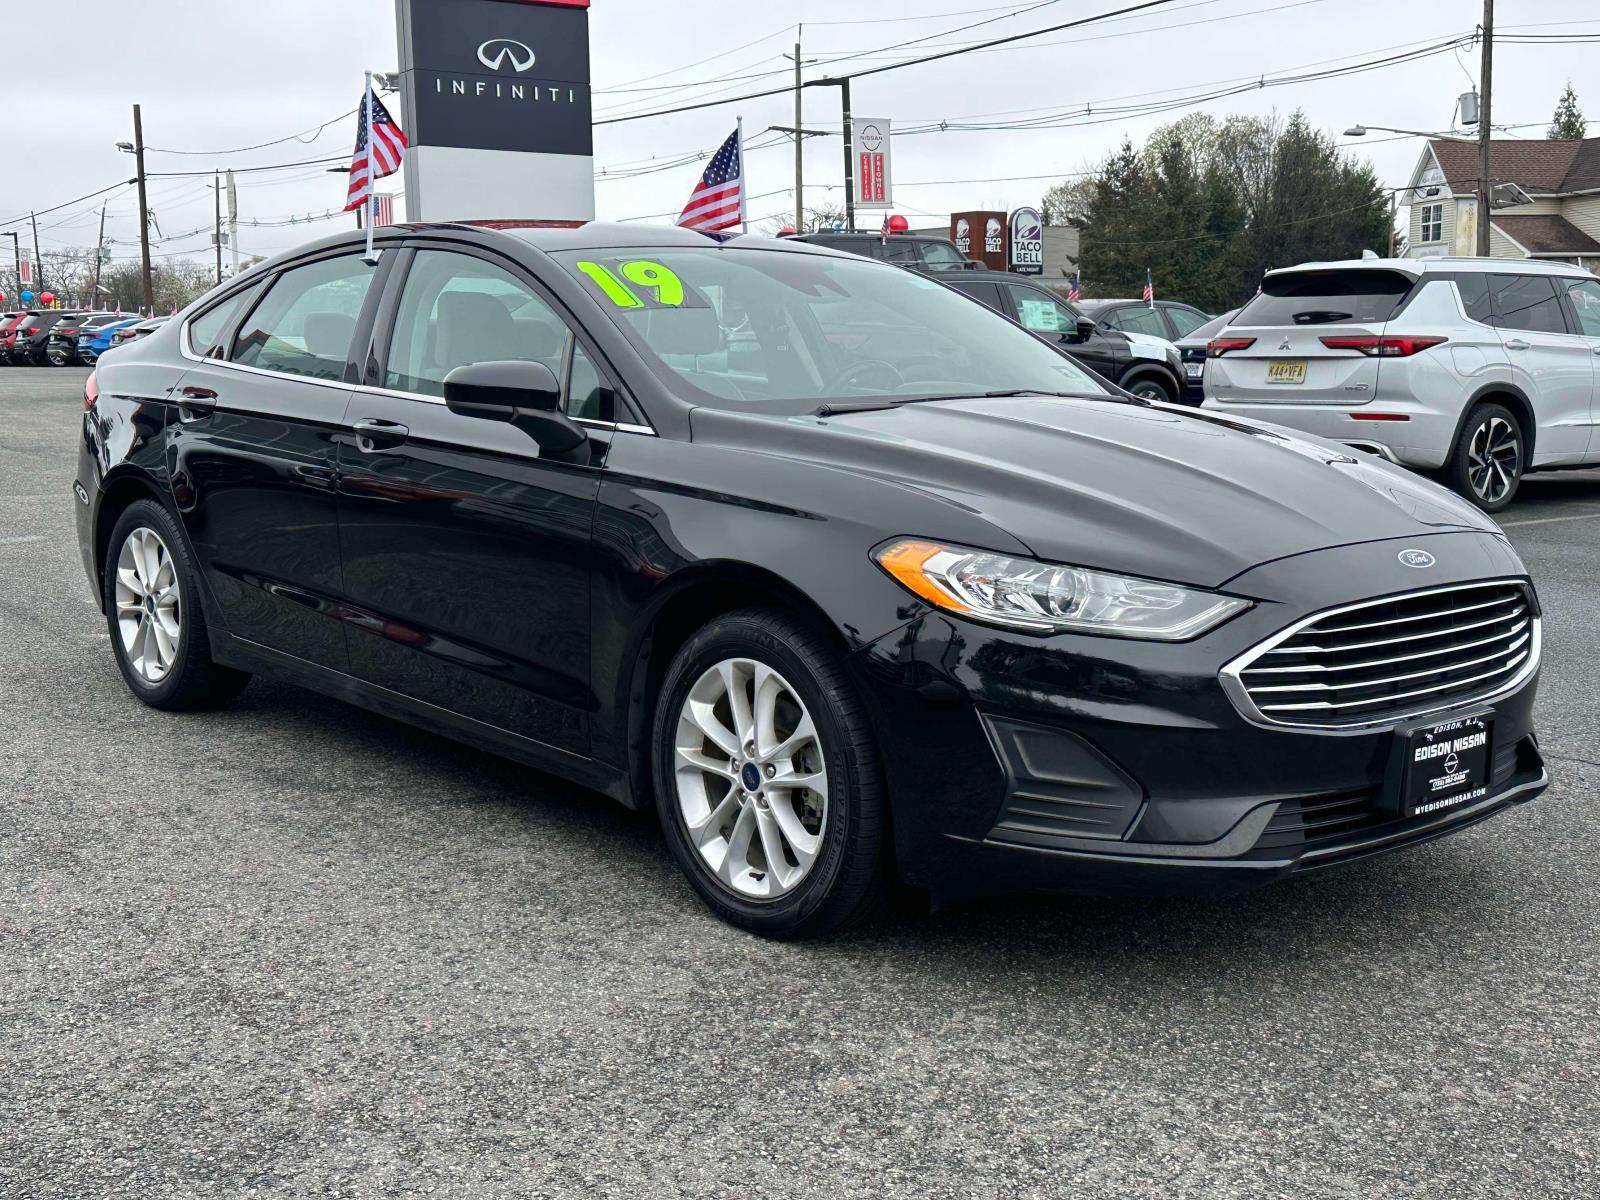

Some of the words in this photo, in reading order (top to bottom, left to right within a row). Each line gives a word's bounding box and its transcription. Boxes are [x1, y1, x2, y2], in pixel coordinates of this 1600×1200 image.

[436, 78, 573, 102] INFINITI
[985, 237, 1001, 245] TACO
[1014, 241, 1041, 252] TACO
[986, 245, 1001, 253] BELL
[1016, 253, 1041, 263] BELL
[576, 261, 684, 308] 19
[1407, 553, 1428, 564] Ford
[1415, 741, 1451, 762] EDISON
[1453, 732, 1486, 752] NISSAN
[1415, 788, 1486, 815] MYEDISONNISSAN.COM
